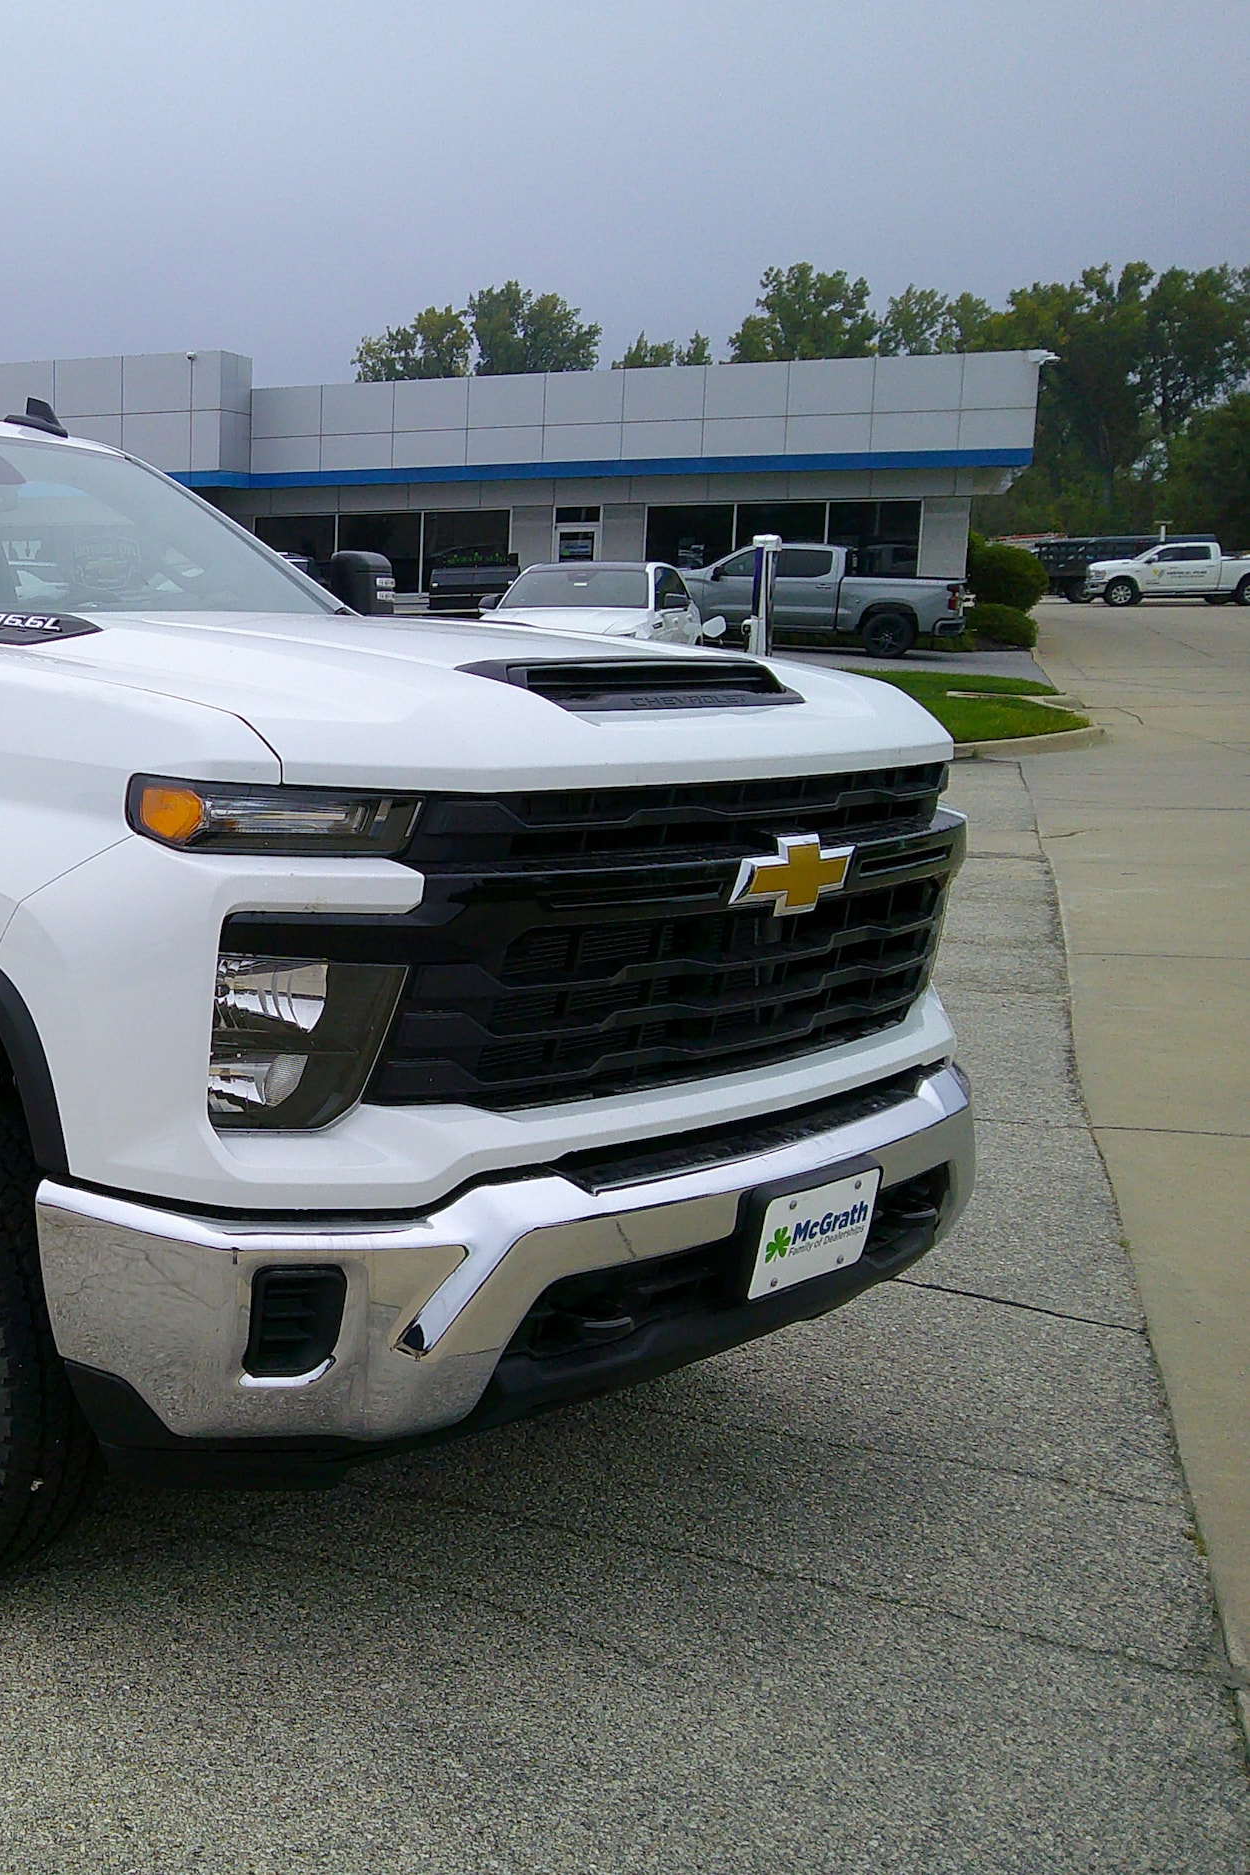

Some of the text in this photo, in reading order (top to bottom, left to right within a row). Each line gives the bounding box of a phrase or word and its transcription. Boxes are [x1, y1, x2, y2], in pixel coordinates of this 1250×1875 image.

[630, 694, 747, 707] CHEVROLET
[791, 1200, 869, 1246] McGrath
[788, 1224, 866, 1257] Family of Dealerships
